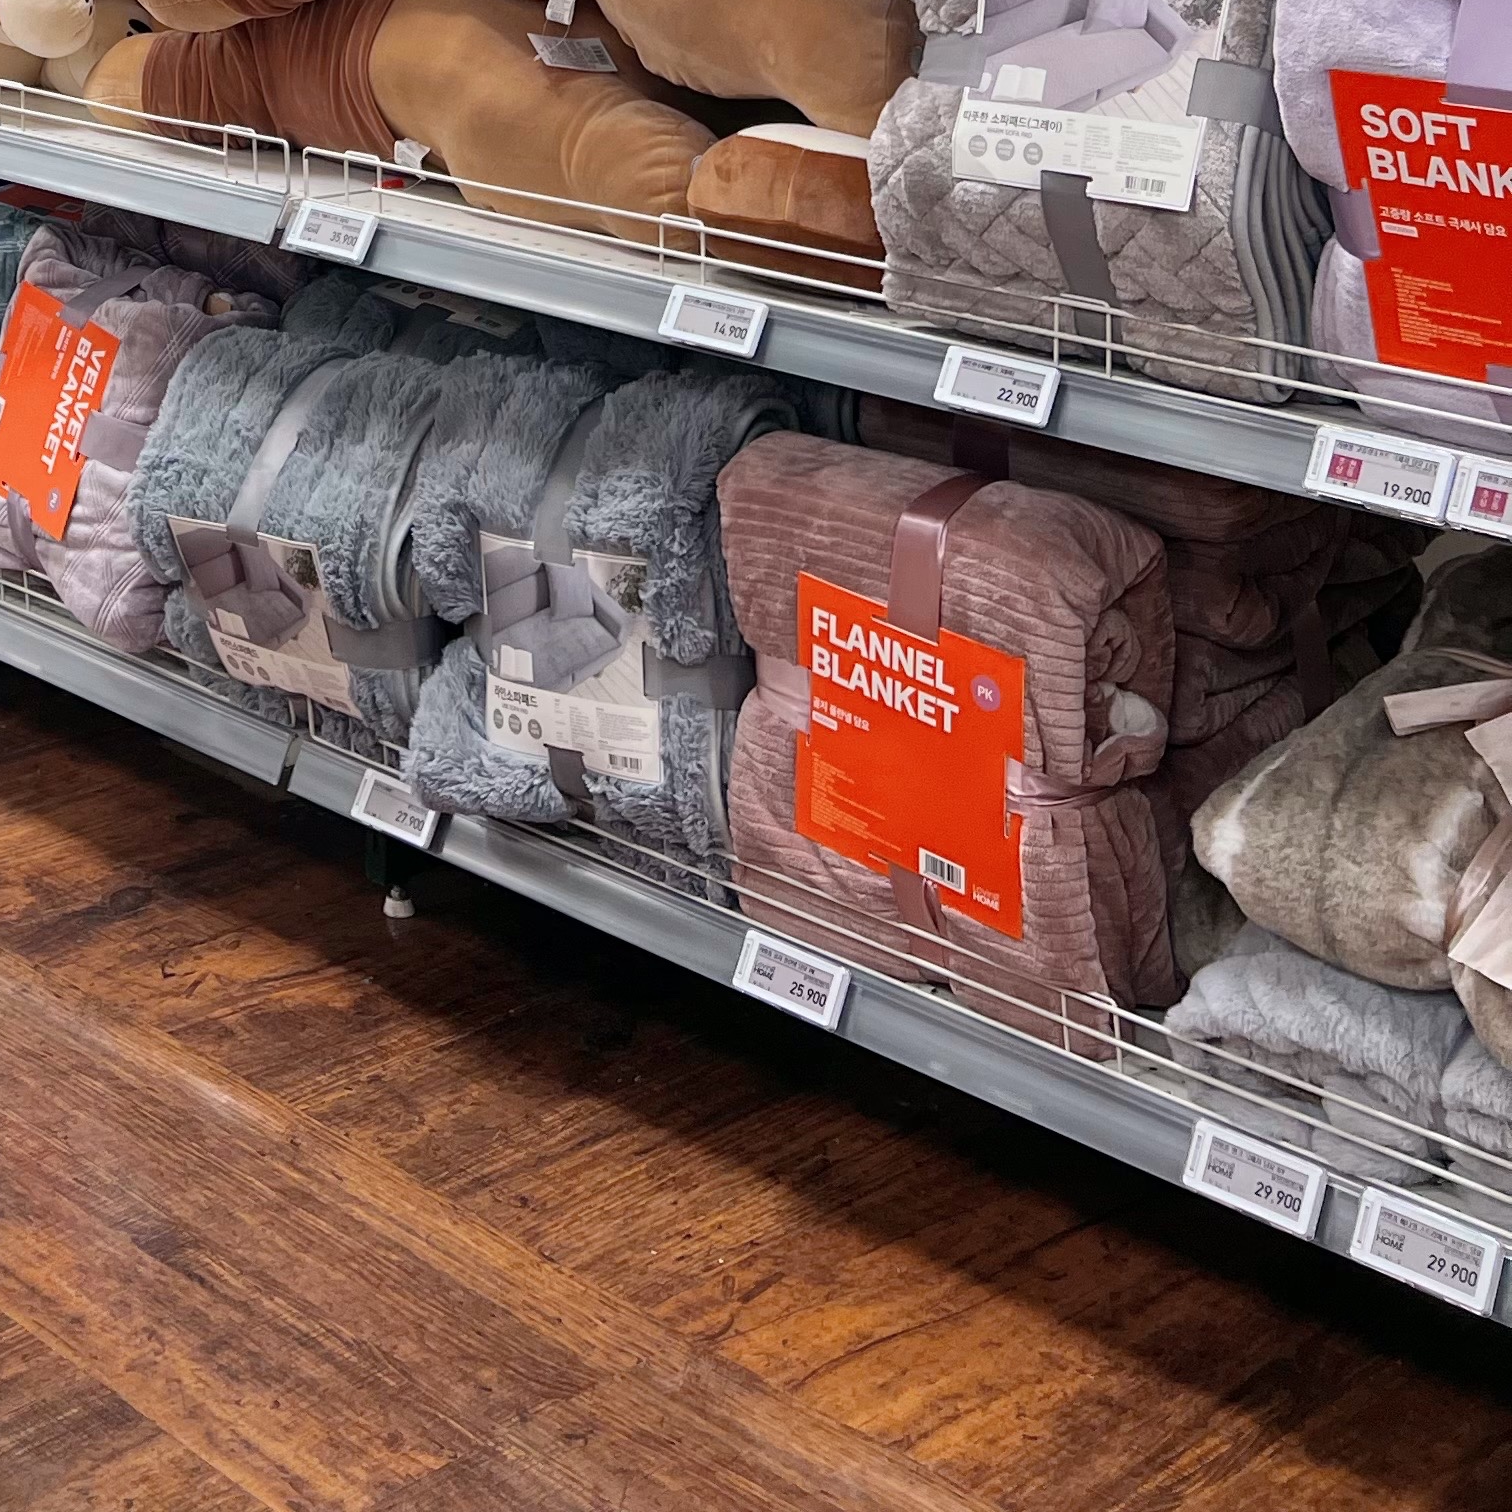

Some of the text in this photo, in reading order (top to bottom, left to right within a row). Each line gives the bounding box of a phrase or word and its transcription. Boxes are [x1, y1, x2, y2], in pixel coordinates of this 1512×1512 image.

[1360, 102, 1478, 152] SOFT
[1413, 210, 1447, 228] 소프트
[40, 336, 93, 475] BLANKET
[62, 349, 106, 461] VELVET
[811, 605, 956, 696] FLANNEL
[811, 643, 960, 735] BLANKET
[976, 683, 994, 703] PK
